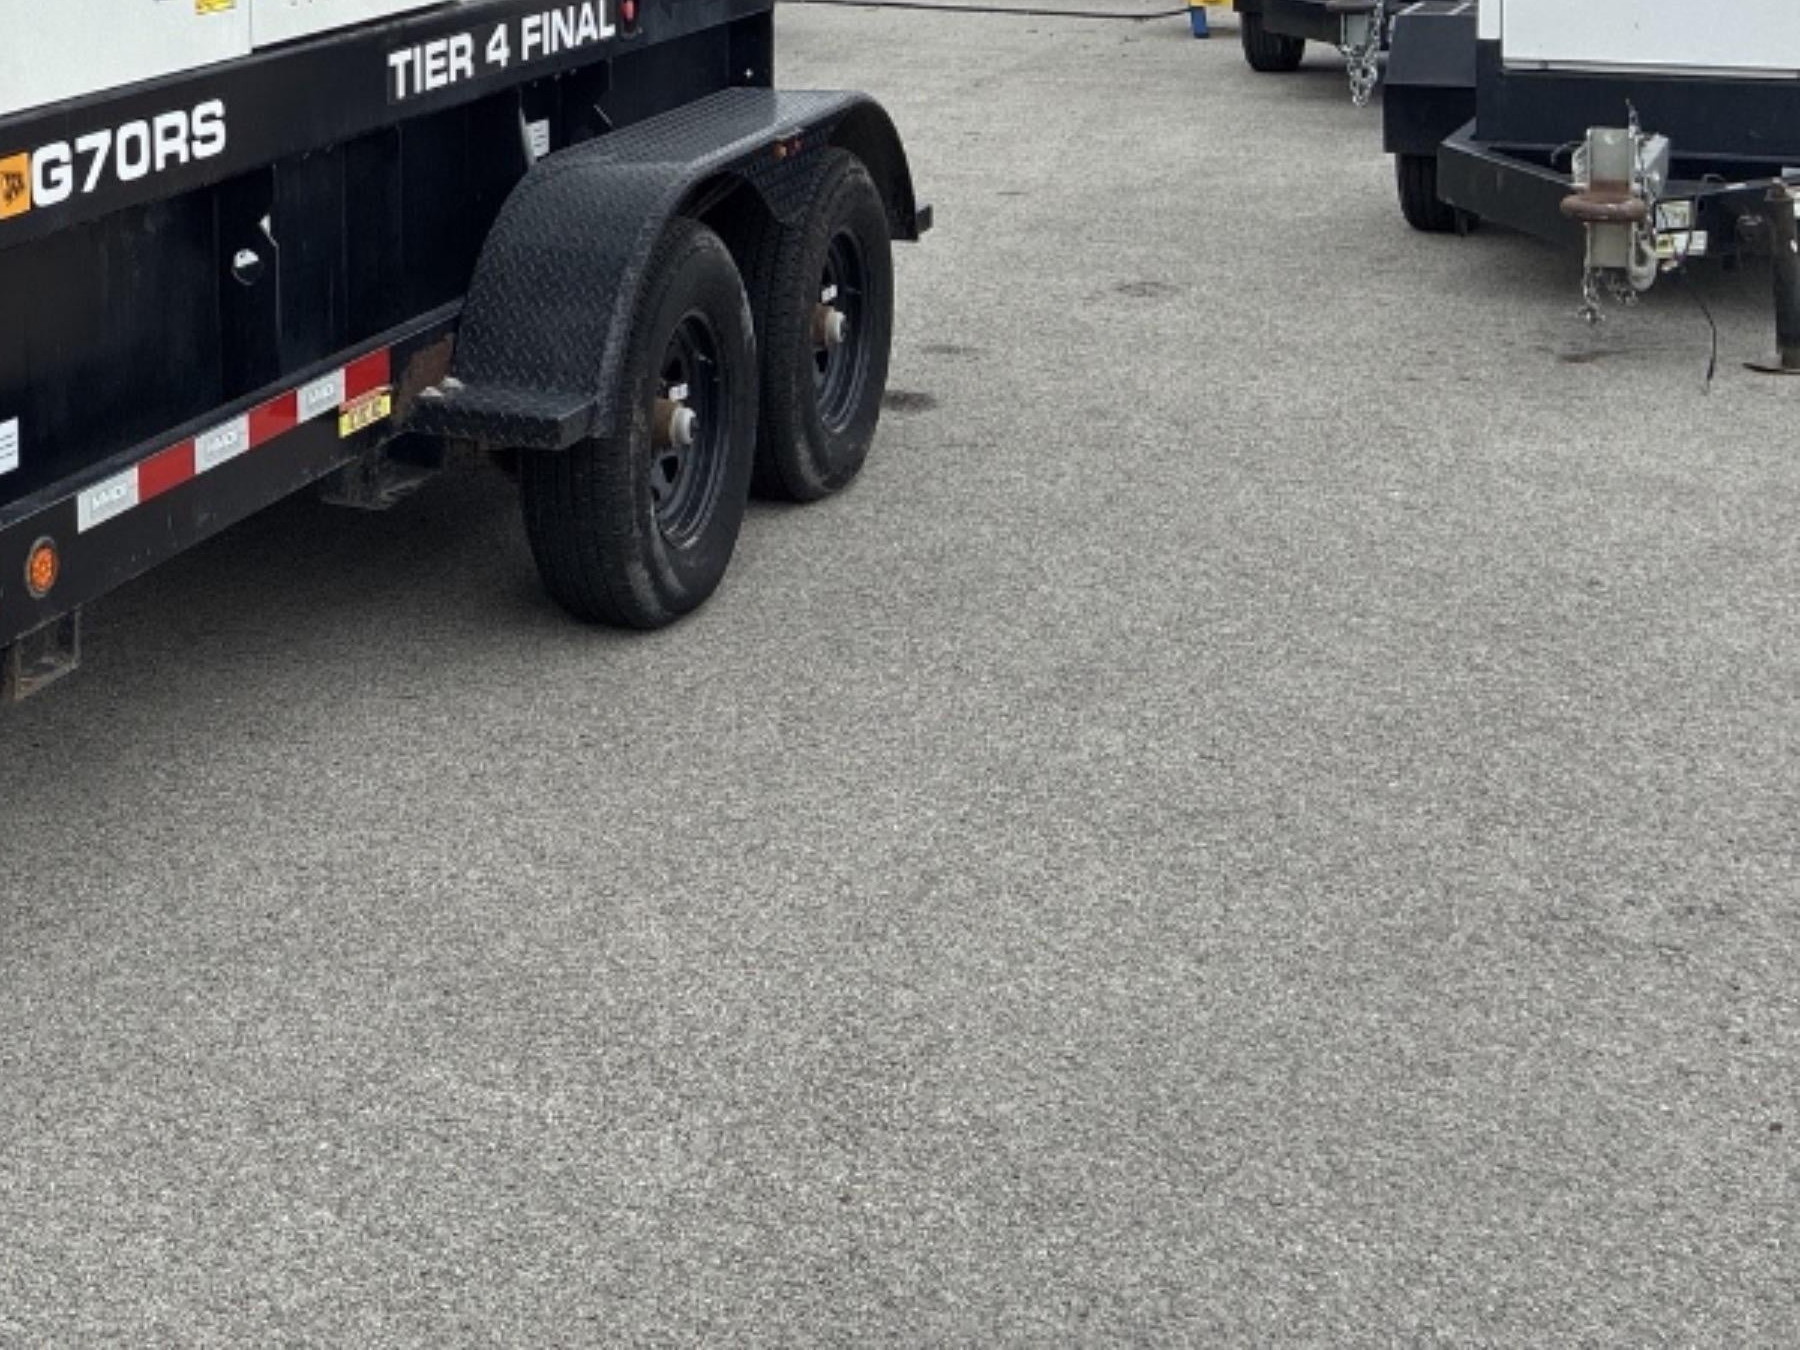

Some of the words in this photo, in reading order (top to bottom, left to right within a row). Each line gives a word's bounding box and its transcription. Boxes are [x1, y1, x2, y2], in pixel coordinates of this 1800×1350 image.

[387, 32, 475, 100] TIER
[484, 22, 511, 68] 4
[31, 97, 227, 208] G70RS
